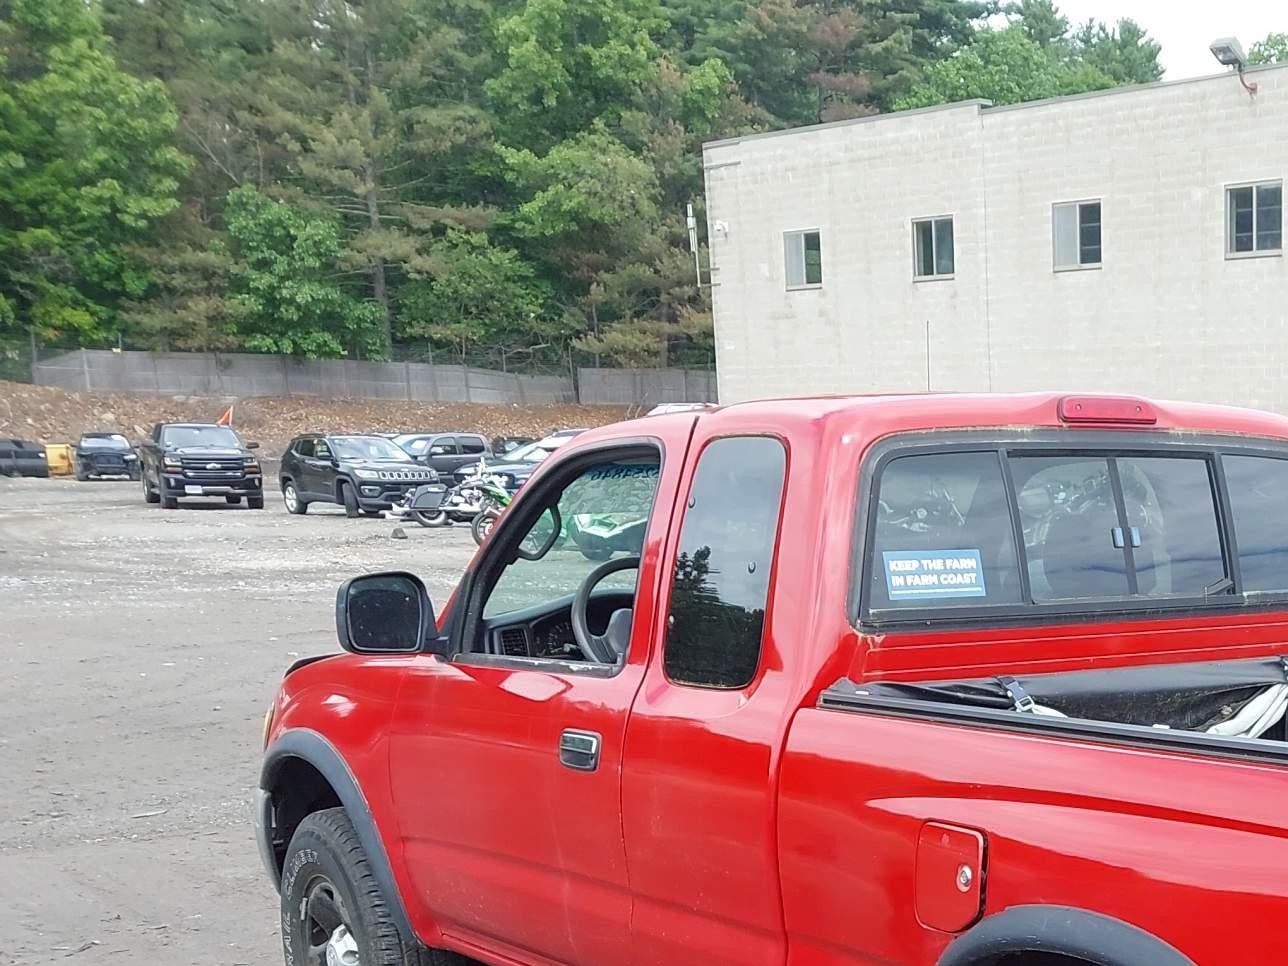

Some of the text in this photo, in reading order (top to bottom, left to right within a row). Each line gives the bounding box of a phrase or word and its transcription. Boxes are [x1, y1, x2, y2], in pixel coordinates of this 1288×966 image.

[889, 558, 977, 571] KEEP THE FARM
[891, 573, 977, 587] IN FARM COAST
